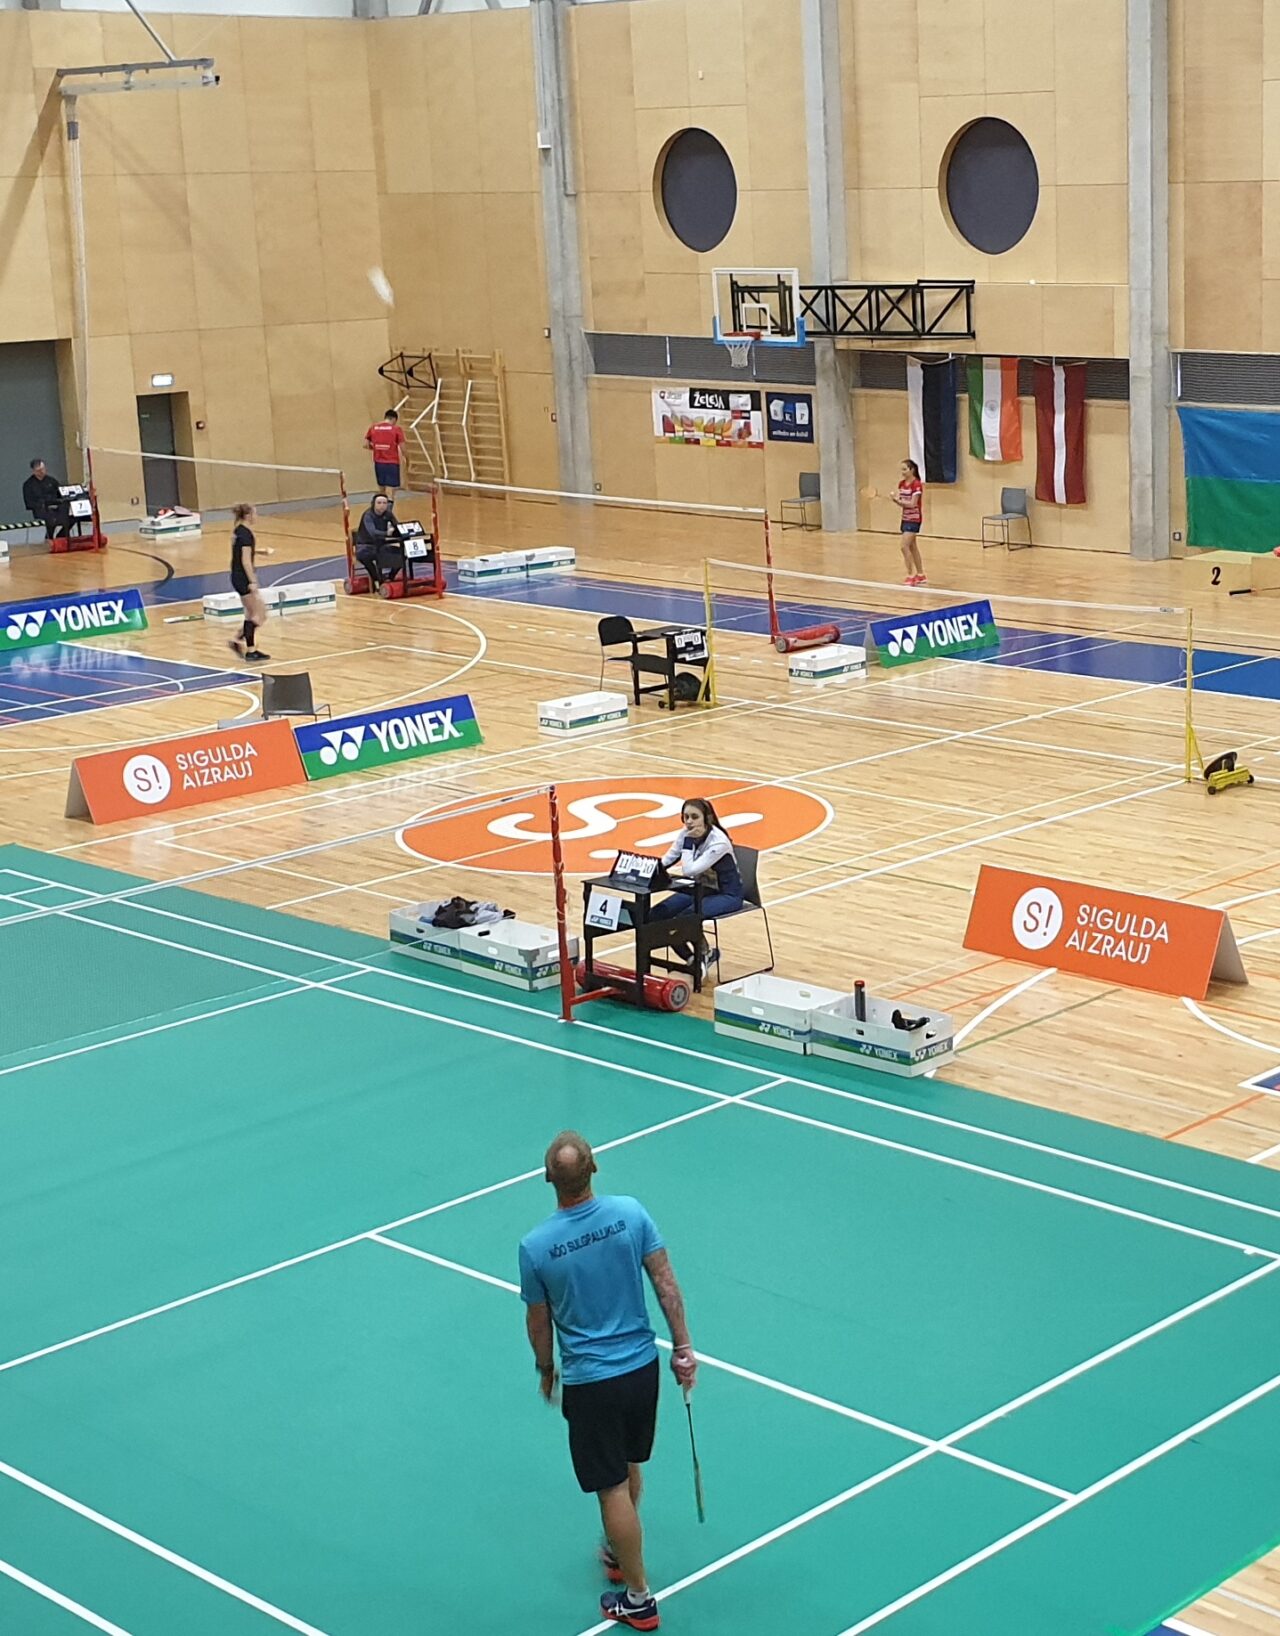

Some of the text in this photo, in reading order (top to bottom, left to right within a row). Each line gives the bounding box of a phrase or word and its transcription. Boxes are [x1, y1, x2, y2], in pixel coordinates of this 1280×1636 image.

[1211, 566, 1221, 585] 2
[50, 599, 131, 632] YONEX
[920, 612, 986, 648] YONEX
[370, 708, 462, 753] YONEX
[182, 760, 253, 790] AIZRAUJ
[599, 899, 609, 916] 4
[1064, 928, 1151, 965] AIZRAUJ
[874, 1046, 899, 1061] YONEX
